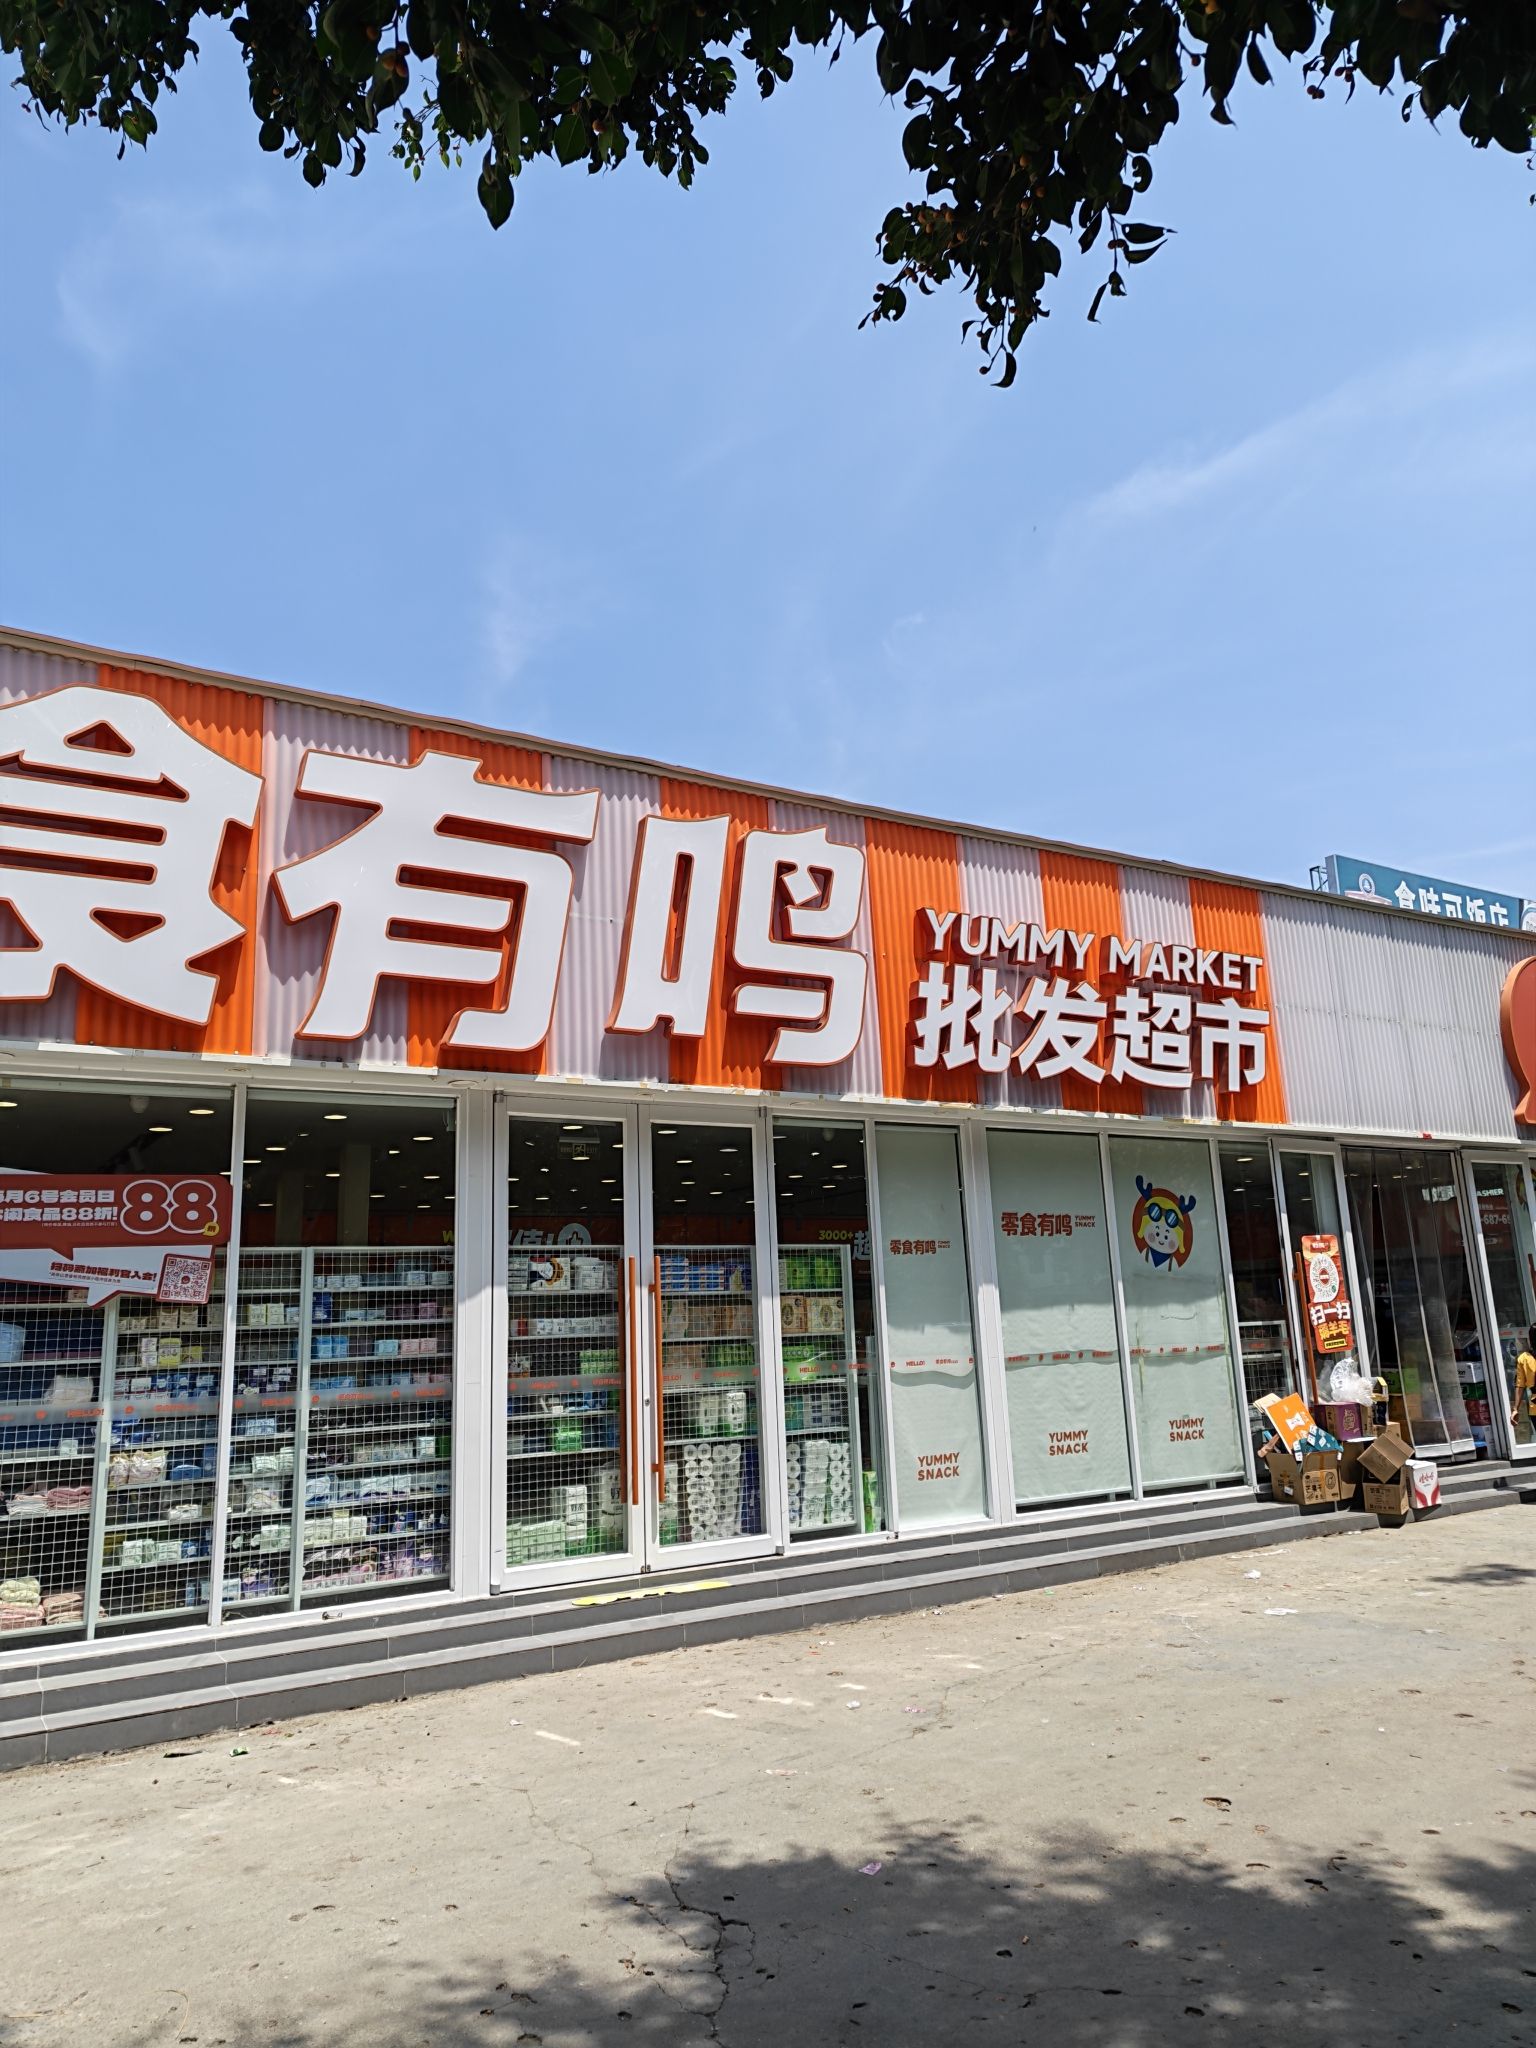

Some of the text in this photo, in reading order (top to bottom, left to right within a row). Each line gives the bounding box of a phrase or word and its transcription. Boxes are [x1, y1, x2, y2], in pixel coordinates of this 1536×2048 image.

[919, 907, 1264, 993] YUMMY MARKET
[912, 961, 1270, 1092] 批发超市
[1476, 1188, 1505, 1197] ASHIER
[120, 1179, 218, 1234] 88
[818, 1230, 854, 1241] 3000+
[1310, 1301, 1351, 1326] 扫一扫
[662, 1374, 683, 1382] ELLO!
[1168, 1417, 1205, 1430] YUMMY
[1048, 1430, 1089, 1444] YUMMY
[1169, 1429, 1205, 1442] SNACK
[1048, 1442, 1089, 1456] SNACK
[917, 1452, 960, 1468] YUMMY
[917, 1466, 960, 1481] SNACK
